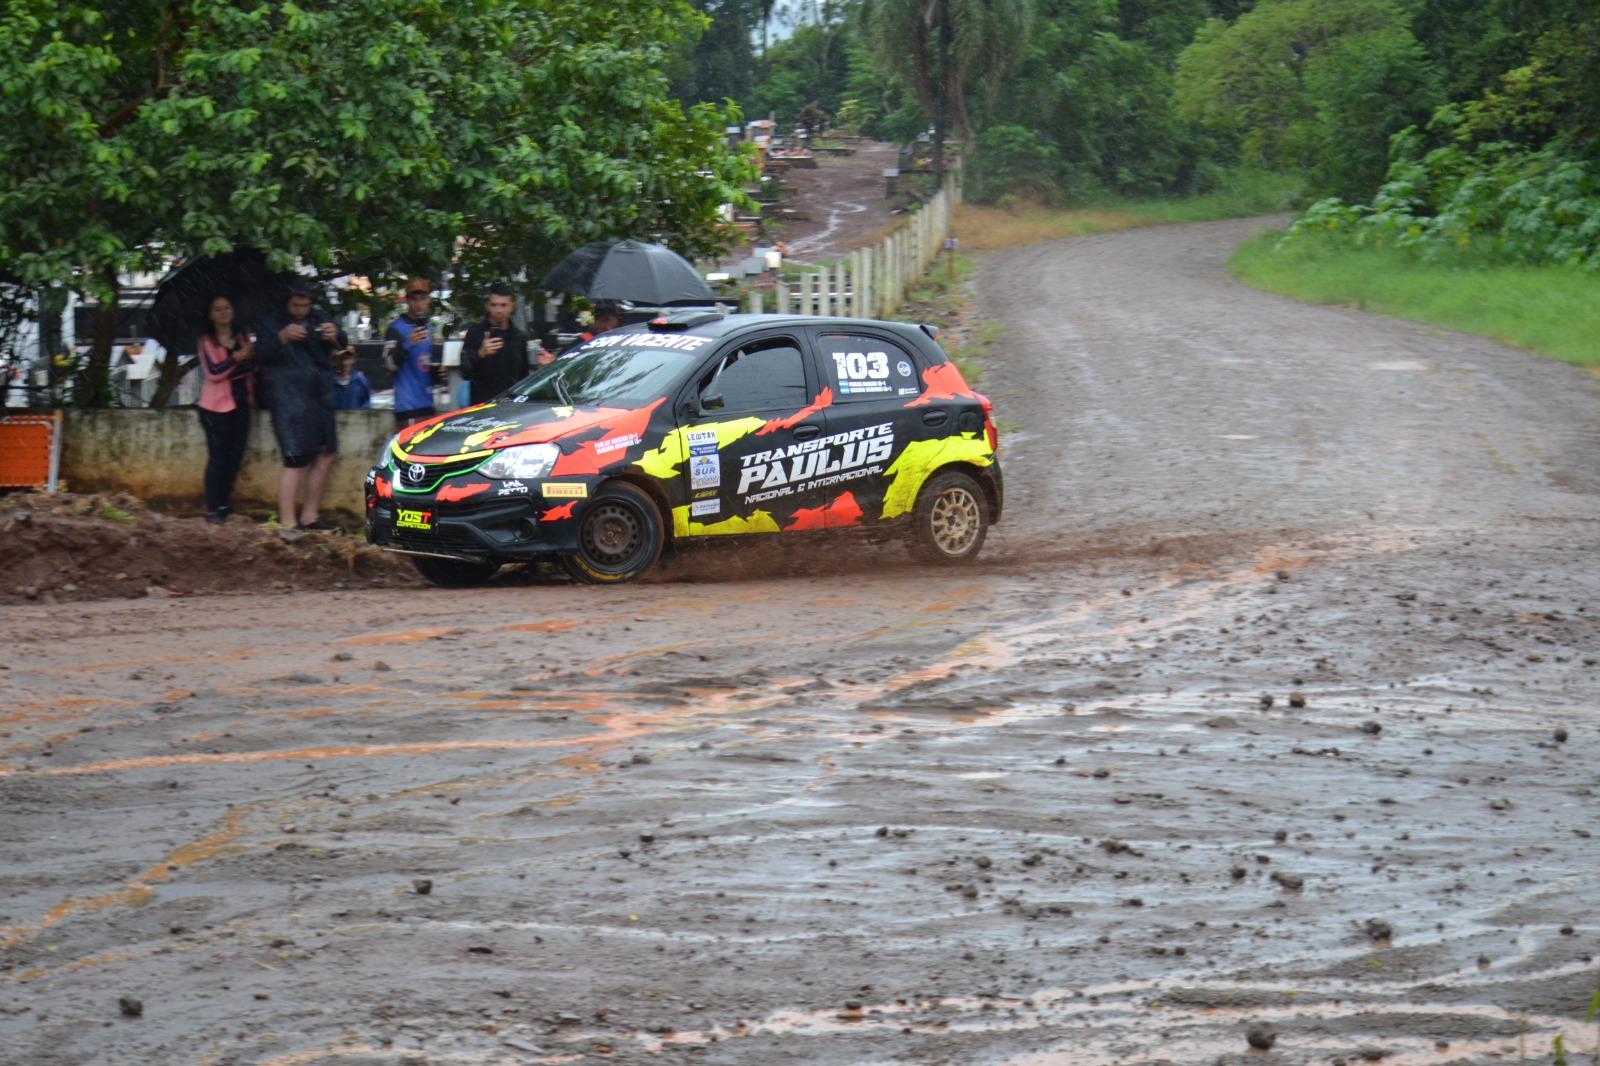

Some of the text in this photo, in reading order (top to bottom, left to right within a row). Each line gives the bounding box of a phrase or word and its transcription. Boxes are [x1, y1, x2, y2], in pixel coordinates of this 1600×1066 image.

[621, 334, 712, 351] VICENTE
[832, 352, 890, 379] 103
[740, 422, 893, 467] TRANSPORTE
[695, 467, 716, 476] SUR
[737, 434, 894, 494] PAULUS
[546, 486, 583, 495] PIRELLI
[745, 465, 883, 505] NACIONAL E INTERNACIONAL
[397, 508, 432, 524] YOST
